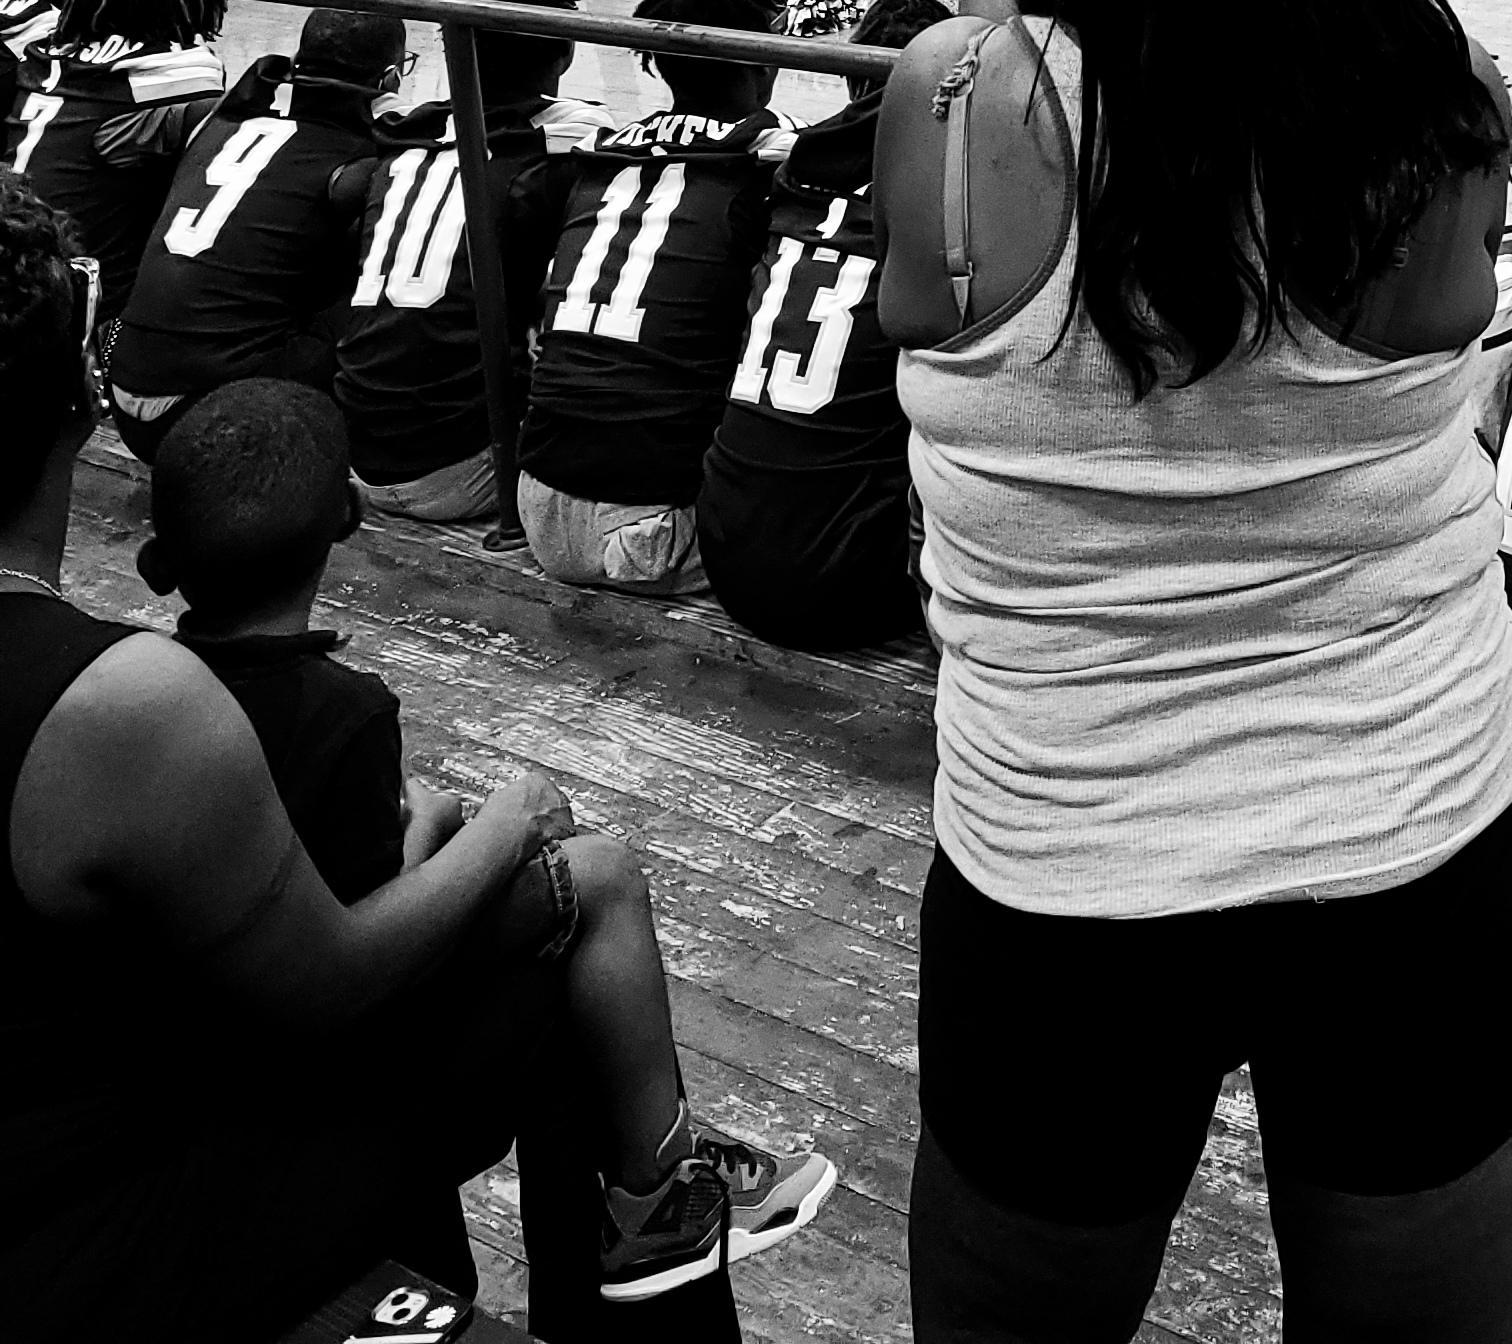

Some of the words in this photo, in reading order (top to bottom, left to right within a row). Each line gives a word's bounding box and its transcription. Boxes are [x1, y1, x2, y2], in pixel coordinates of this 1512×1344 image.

[12, 92, 65, 175] 7
[163, 117, 298, 258] 9
[352, 148, 468, 309] 10
[553, 162, 687, 343] 11
[730, 236, 877, 415] 13
